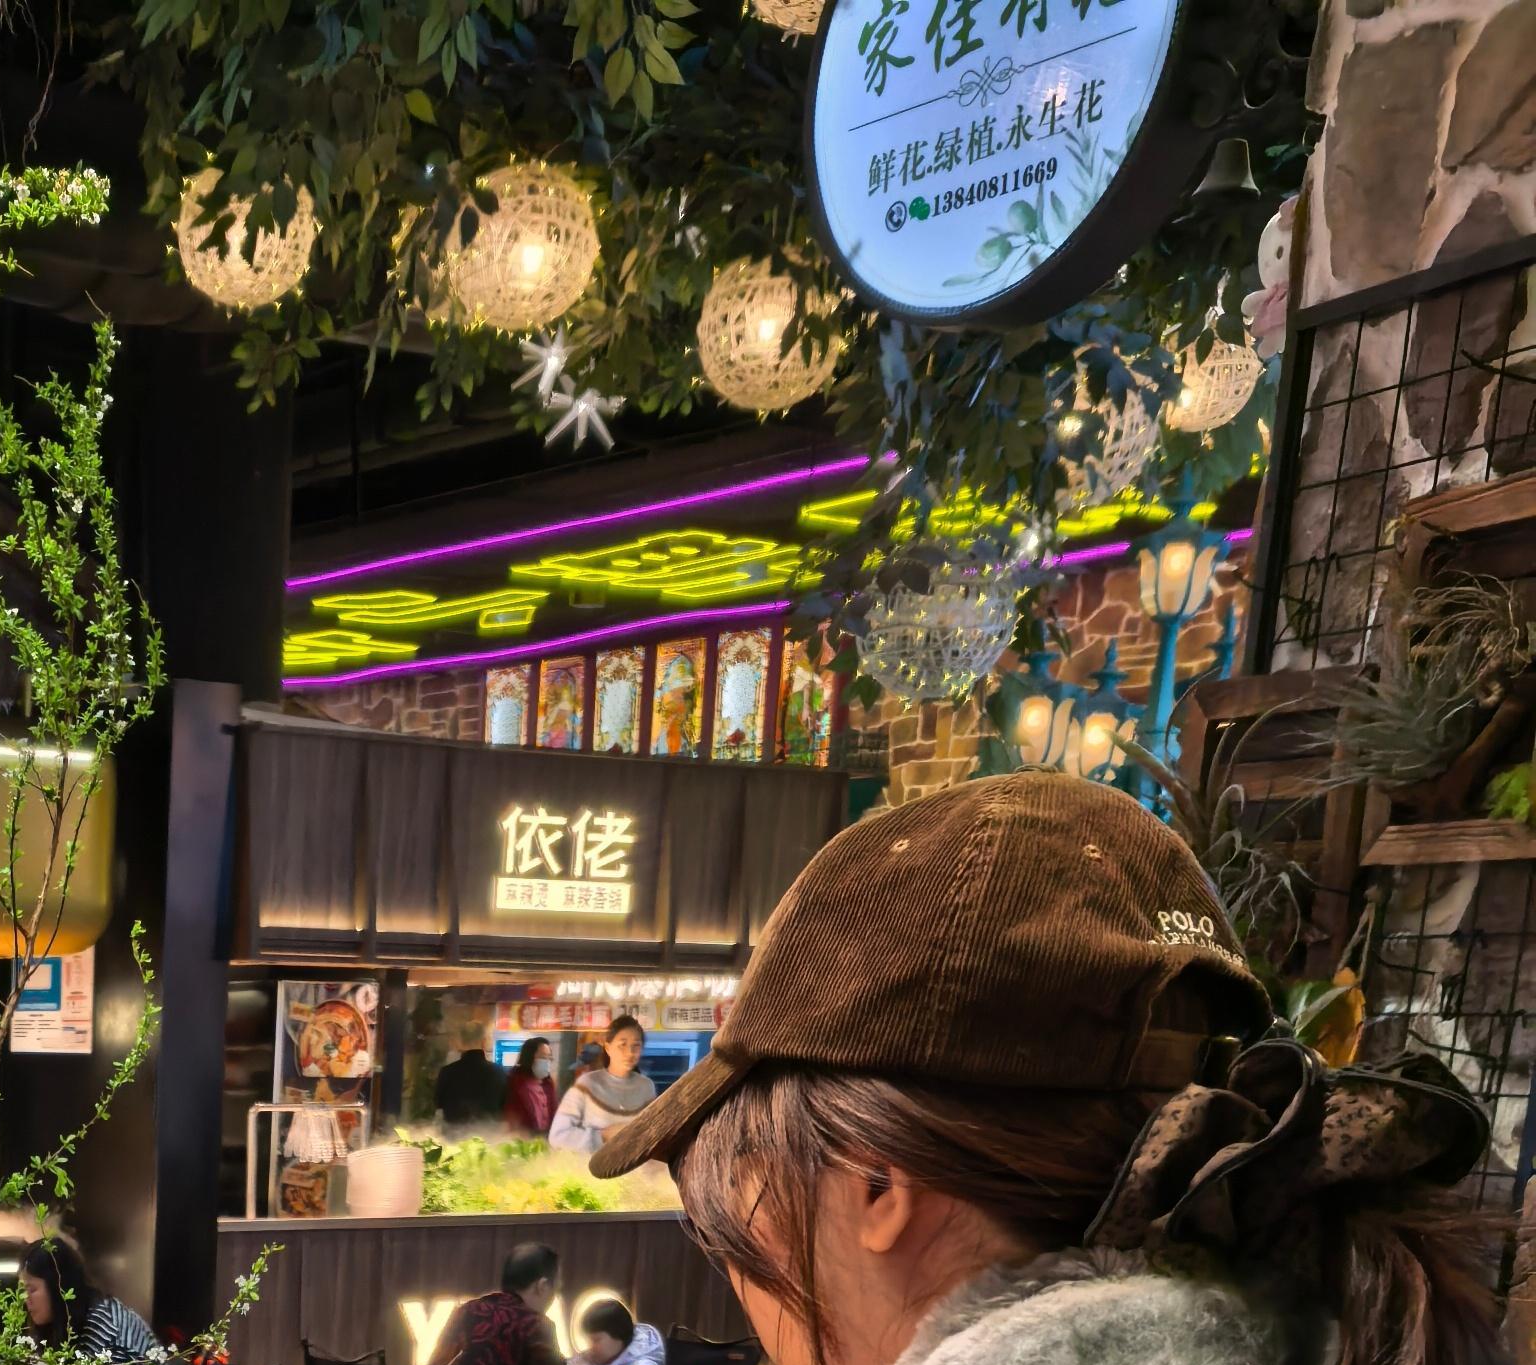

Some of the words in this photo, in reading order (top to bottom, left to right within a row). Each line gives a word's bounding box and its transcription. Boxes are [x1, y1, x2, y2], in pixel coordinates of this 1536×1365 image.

[930, 157, 1058, 217] 13840811669
[501, 805, 636, 878] 依佬
[1157, 910, 1214, 937] POLO
